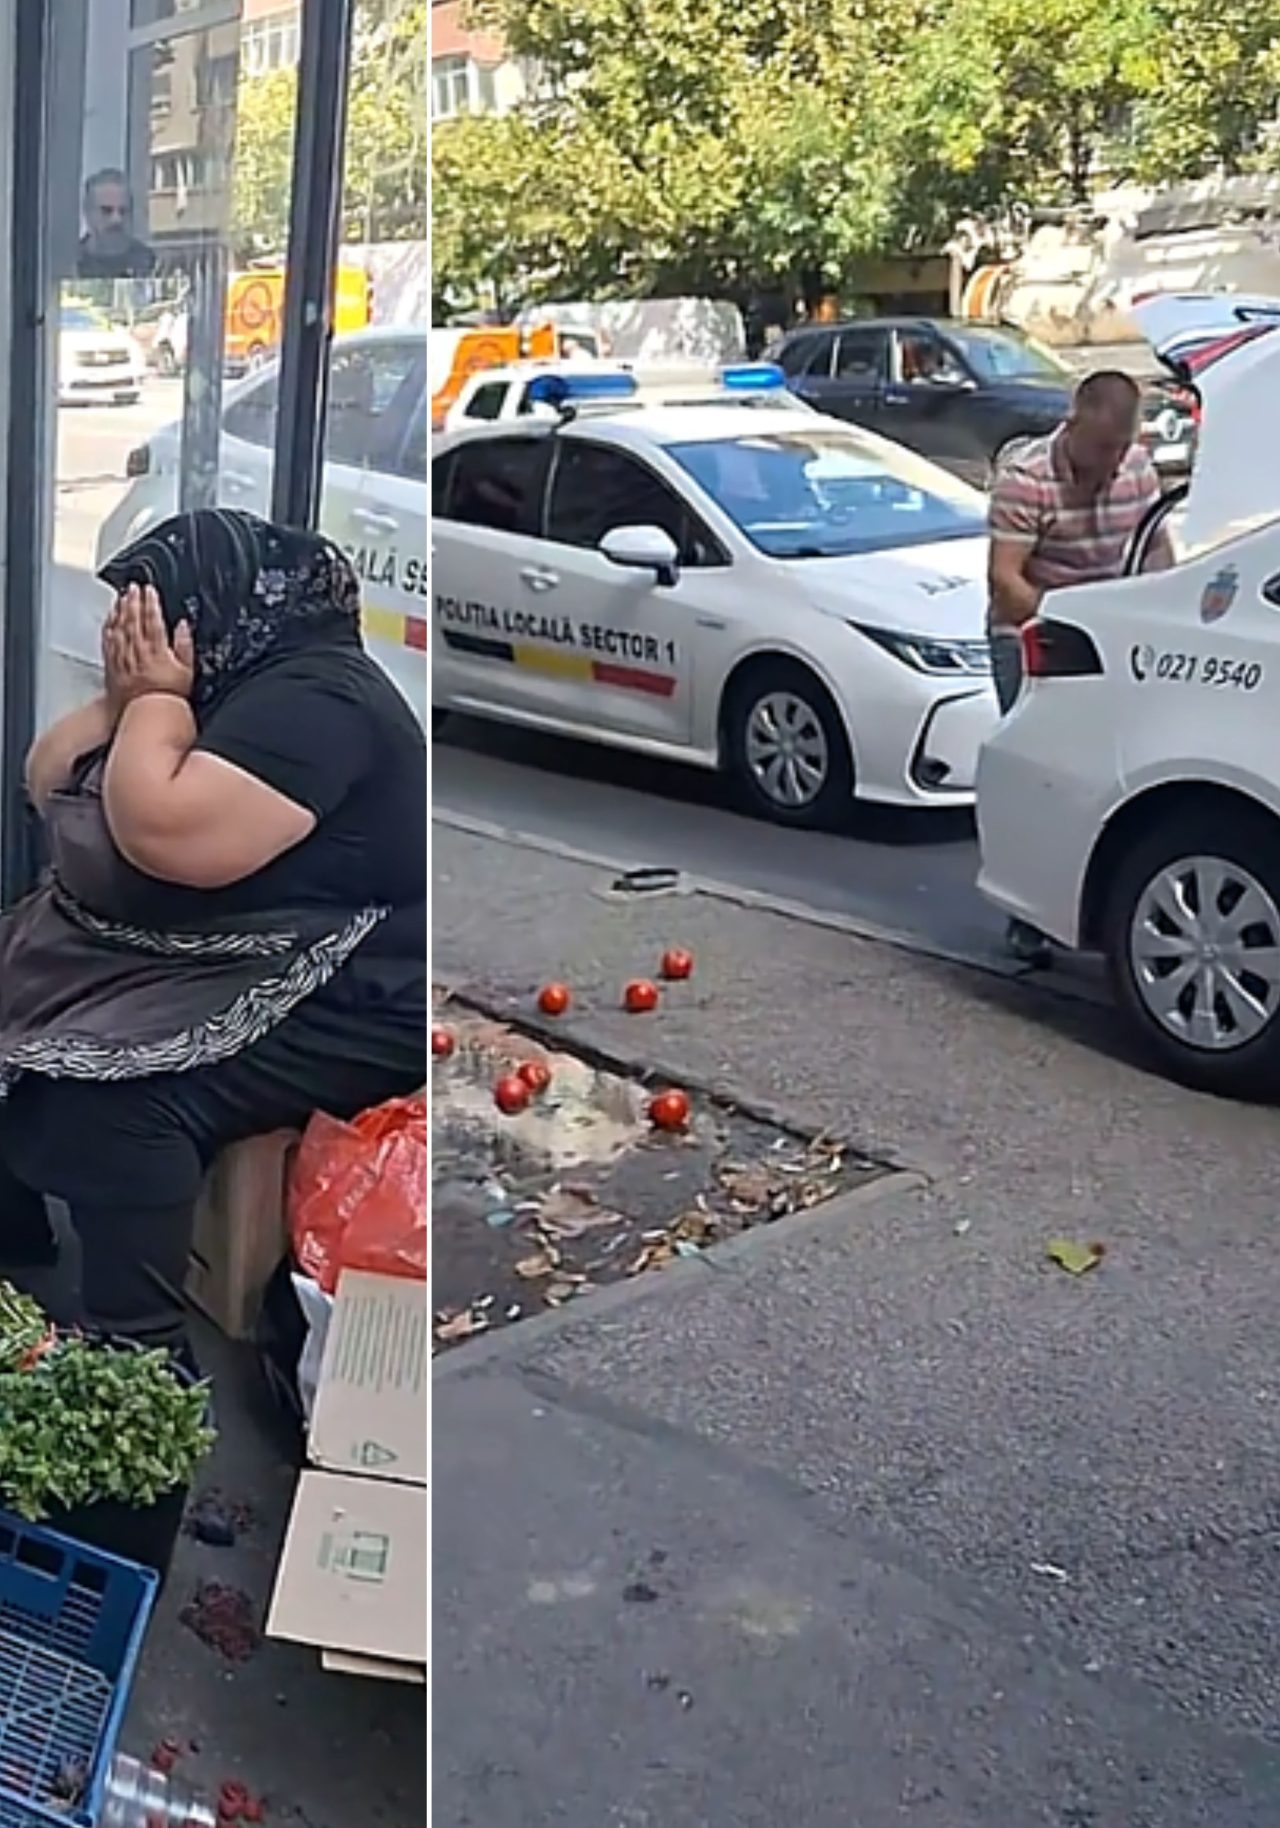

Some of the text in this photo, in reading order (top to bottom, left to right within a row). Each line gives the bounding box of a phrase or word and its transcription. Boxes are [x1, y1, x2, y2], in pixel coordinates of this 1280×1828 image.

[580, 622, 660, 662] SECTOR
[666, 640, 675, 664] 1
[1156, 653, 1261, 690] 021 9540
